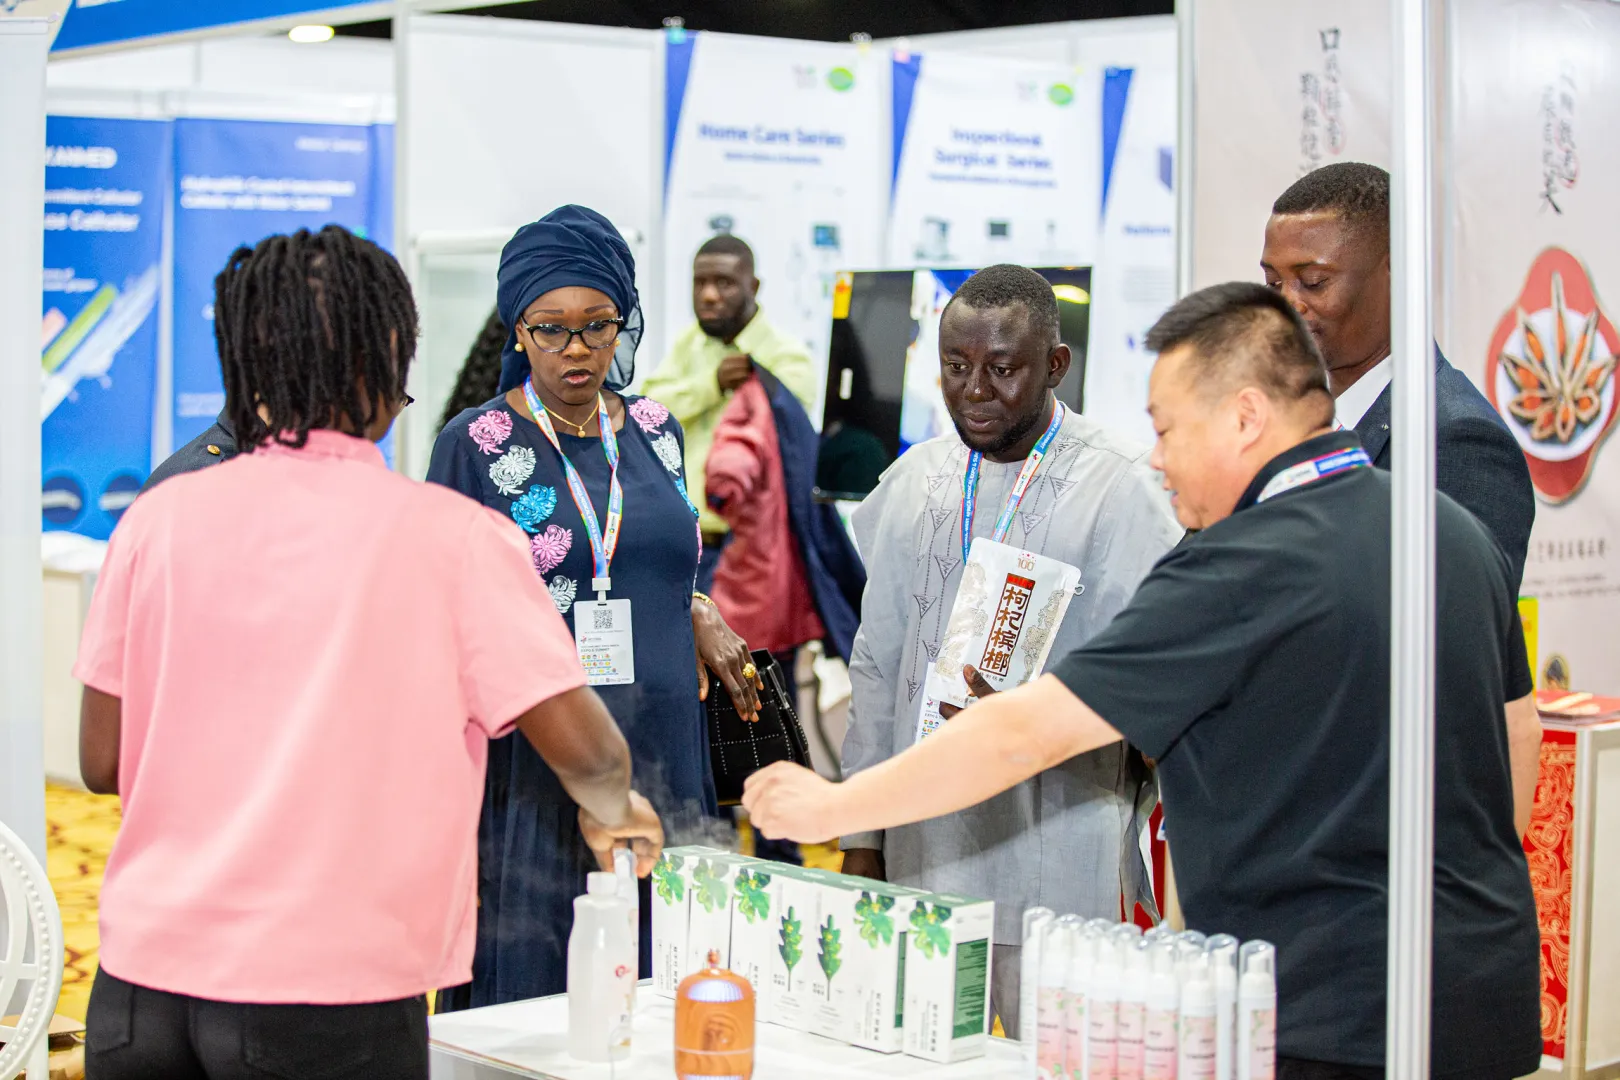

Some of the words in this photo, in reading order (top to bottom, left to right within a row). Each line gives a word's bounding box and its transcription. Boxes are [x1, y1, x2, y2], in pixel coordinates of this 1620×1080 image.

[1017, 557, 1035, 572] 100
[984, 587, 1028, 672] 枸杞槟榔
